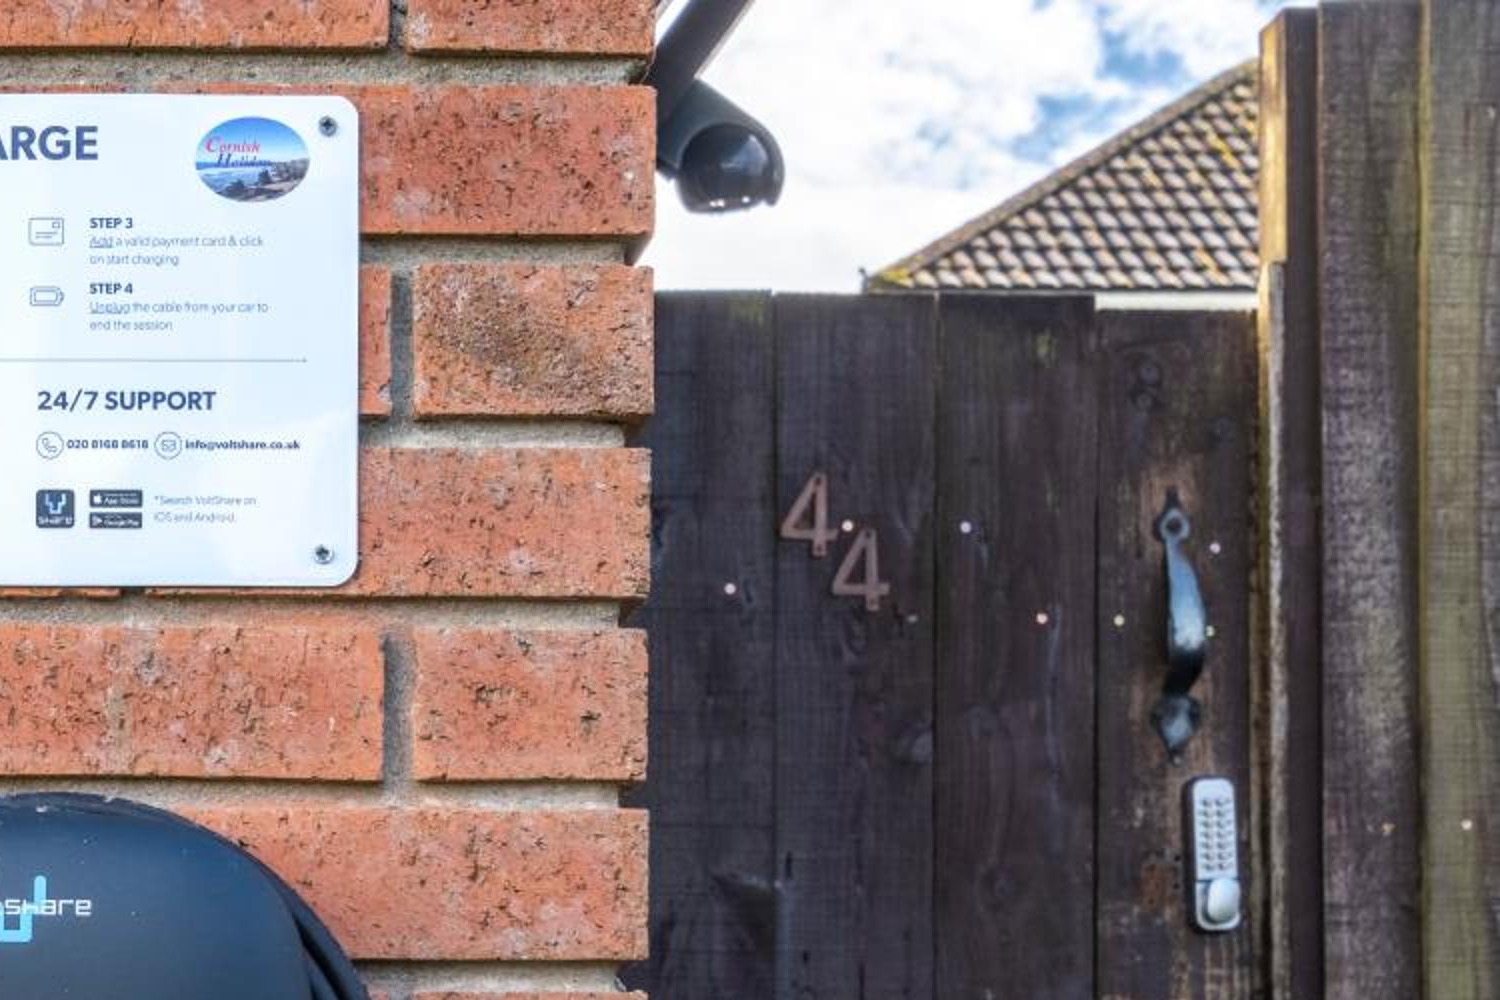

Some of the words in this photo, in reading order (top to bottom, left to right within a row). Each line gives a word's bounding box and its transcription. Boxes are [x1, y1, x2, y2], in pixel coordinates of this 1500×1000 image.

[90, 218, 121, 228] STEP
[125, 218, 133, 228] 3
[90, 236, 113, 248] Add
[116, 238, 122, 246] a
[125, 236, 149, 247] valid
[152, 237, 199, 248] payment
[202, 236, 225, 247] card
[228, 236, 237, 247] &
[239, 236, 264, 247] click
[90, 256, 104, 264] on
[107, 255, 129, 264] start
[132, 254, 179, 266] charging
[90, 283, 121, 294] STEP
[124, 283, 133, 294] 4
[90, 302, 131, 314] Unplug
[133, 302, 149, 312] the
[152, 302, 181, 312] cable
[185, 302, 208, 312] from
[211, 304, 235, 314] your
[237, 303, 255, 312] car
[258, 302, 268, 312] to
[90, 320, 110, 331] end
[113, 320, 131, 331] the
[133, 320, 172, 331] session
[38, 390, 98, 412] 24/7
[105, 391, 215, 410] SUPPORT
[67, 440, 88, 449] 020
[91, 440, 118, 449] 8168
[185, 440, 300, 450] info@voltshare.co.uk
[195, 495, 241, 505] VoltShare
[174, 513, 194, 522] and
[196, 513, 235, 522] Android.
